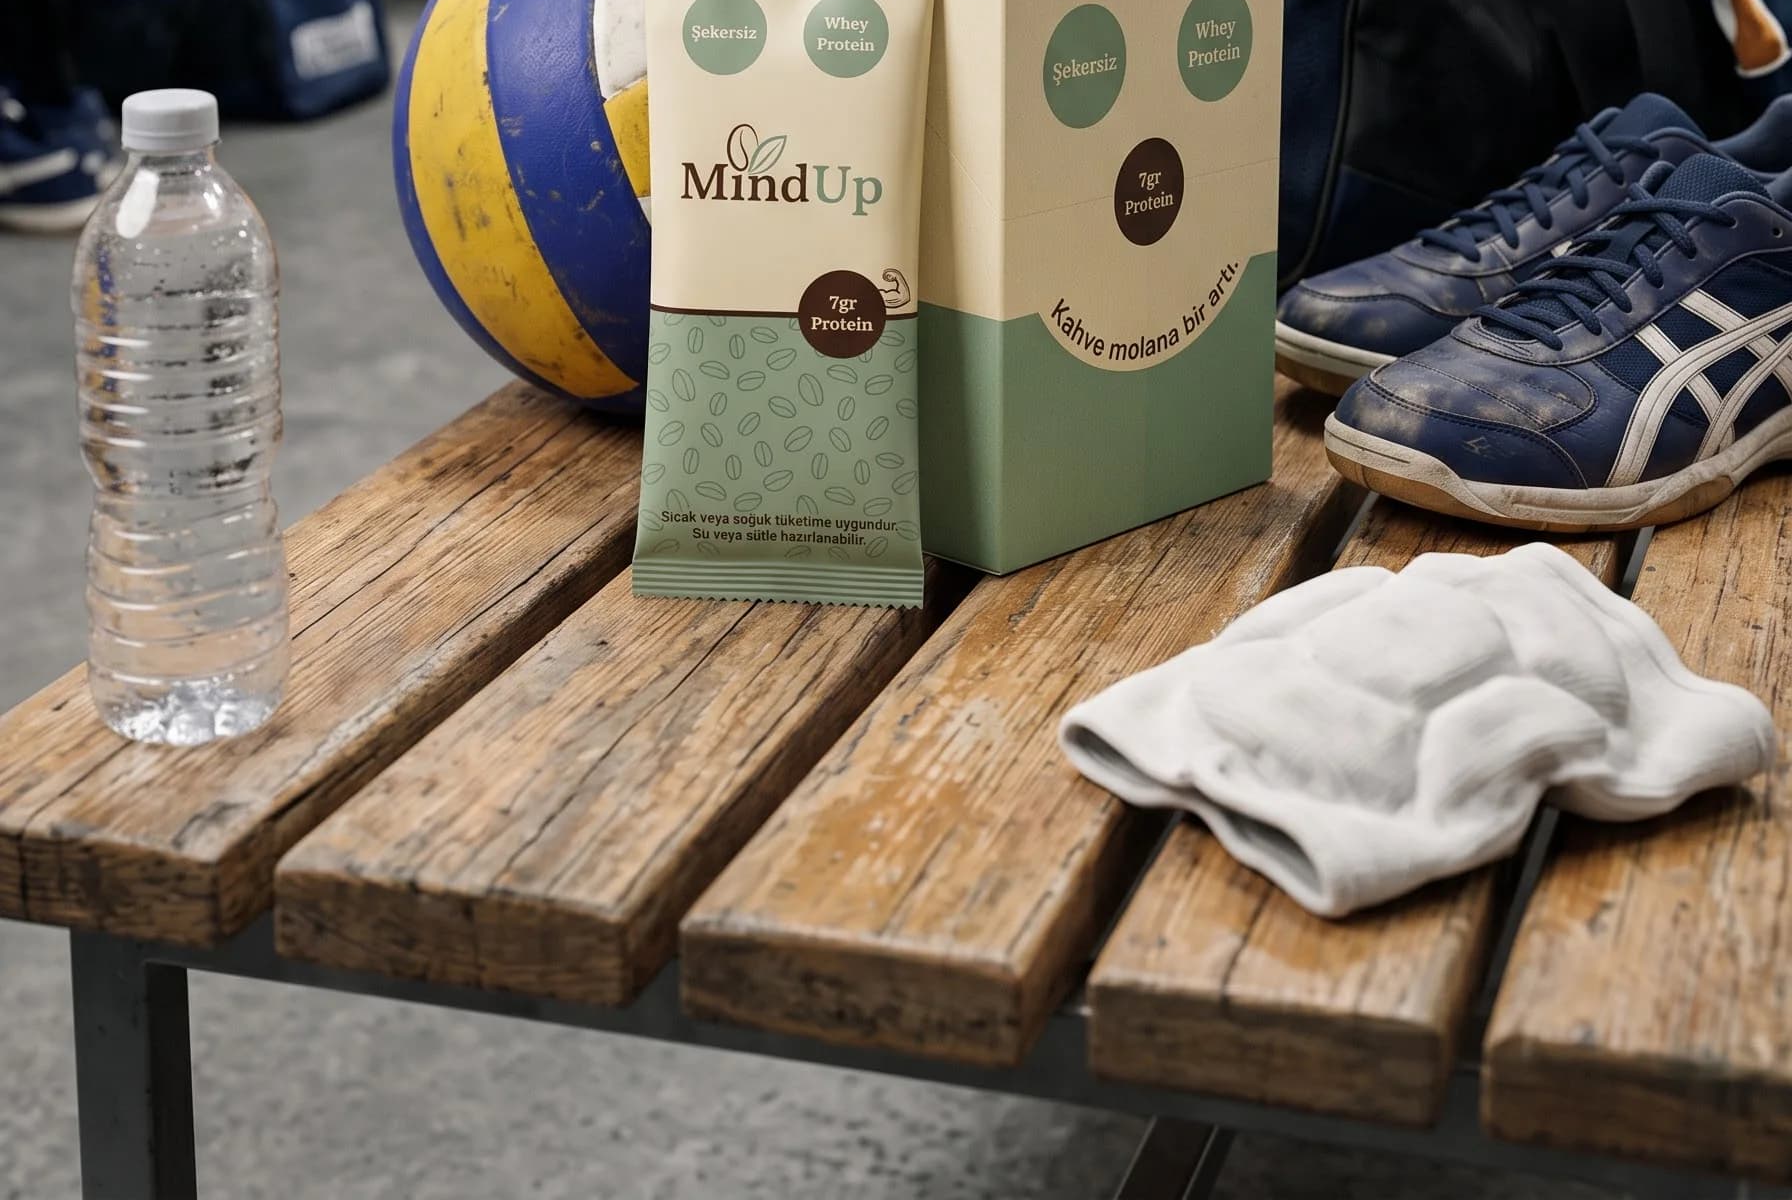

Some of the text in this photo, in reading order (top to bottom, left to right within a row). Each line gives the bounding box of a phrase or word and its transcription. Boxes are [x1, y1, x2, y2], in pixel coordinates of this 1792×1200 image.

[691, 25, 757, 43] Şekersiz
[823, 16, 869, 34] Whey
[1195, 20, 1236, 40] Whey
[816, 38, 875, 53] Protein
[1188, 43, 1241, 68] Protein
[1052, 53, 1118, 86] Şekersiz
[680, 162, 883, 216] MindUp
[1138, 171, 1162, 191] 7gr
[1124, 191, 1174, 216] Protein
[829, 295, 857, 313] 7gr
[810, 316, 873, 332] Protein
[1051, 298, 1105, 356] Kahve
[1108, 328, 1180, 361] molana
[1182, 303, 1206, 336] bir
[700, 514, 730, 526] veya
[775, 515, 832, 528] tüketime
[835, 518, 899, 532] uygundur.
[692, 527, 867, 546] Su veya sütle hazırlanabilir.
